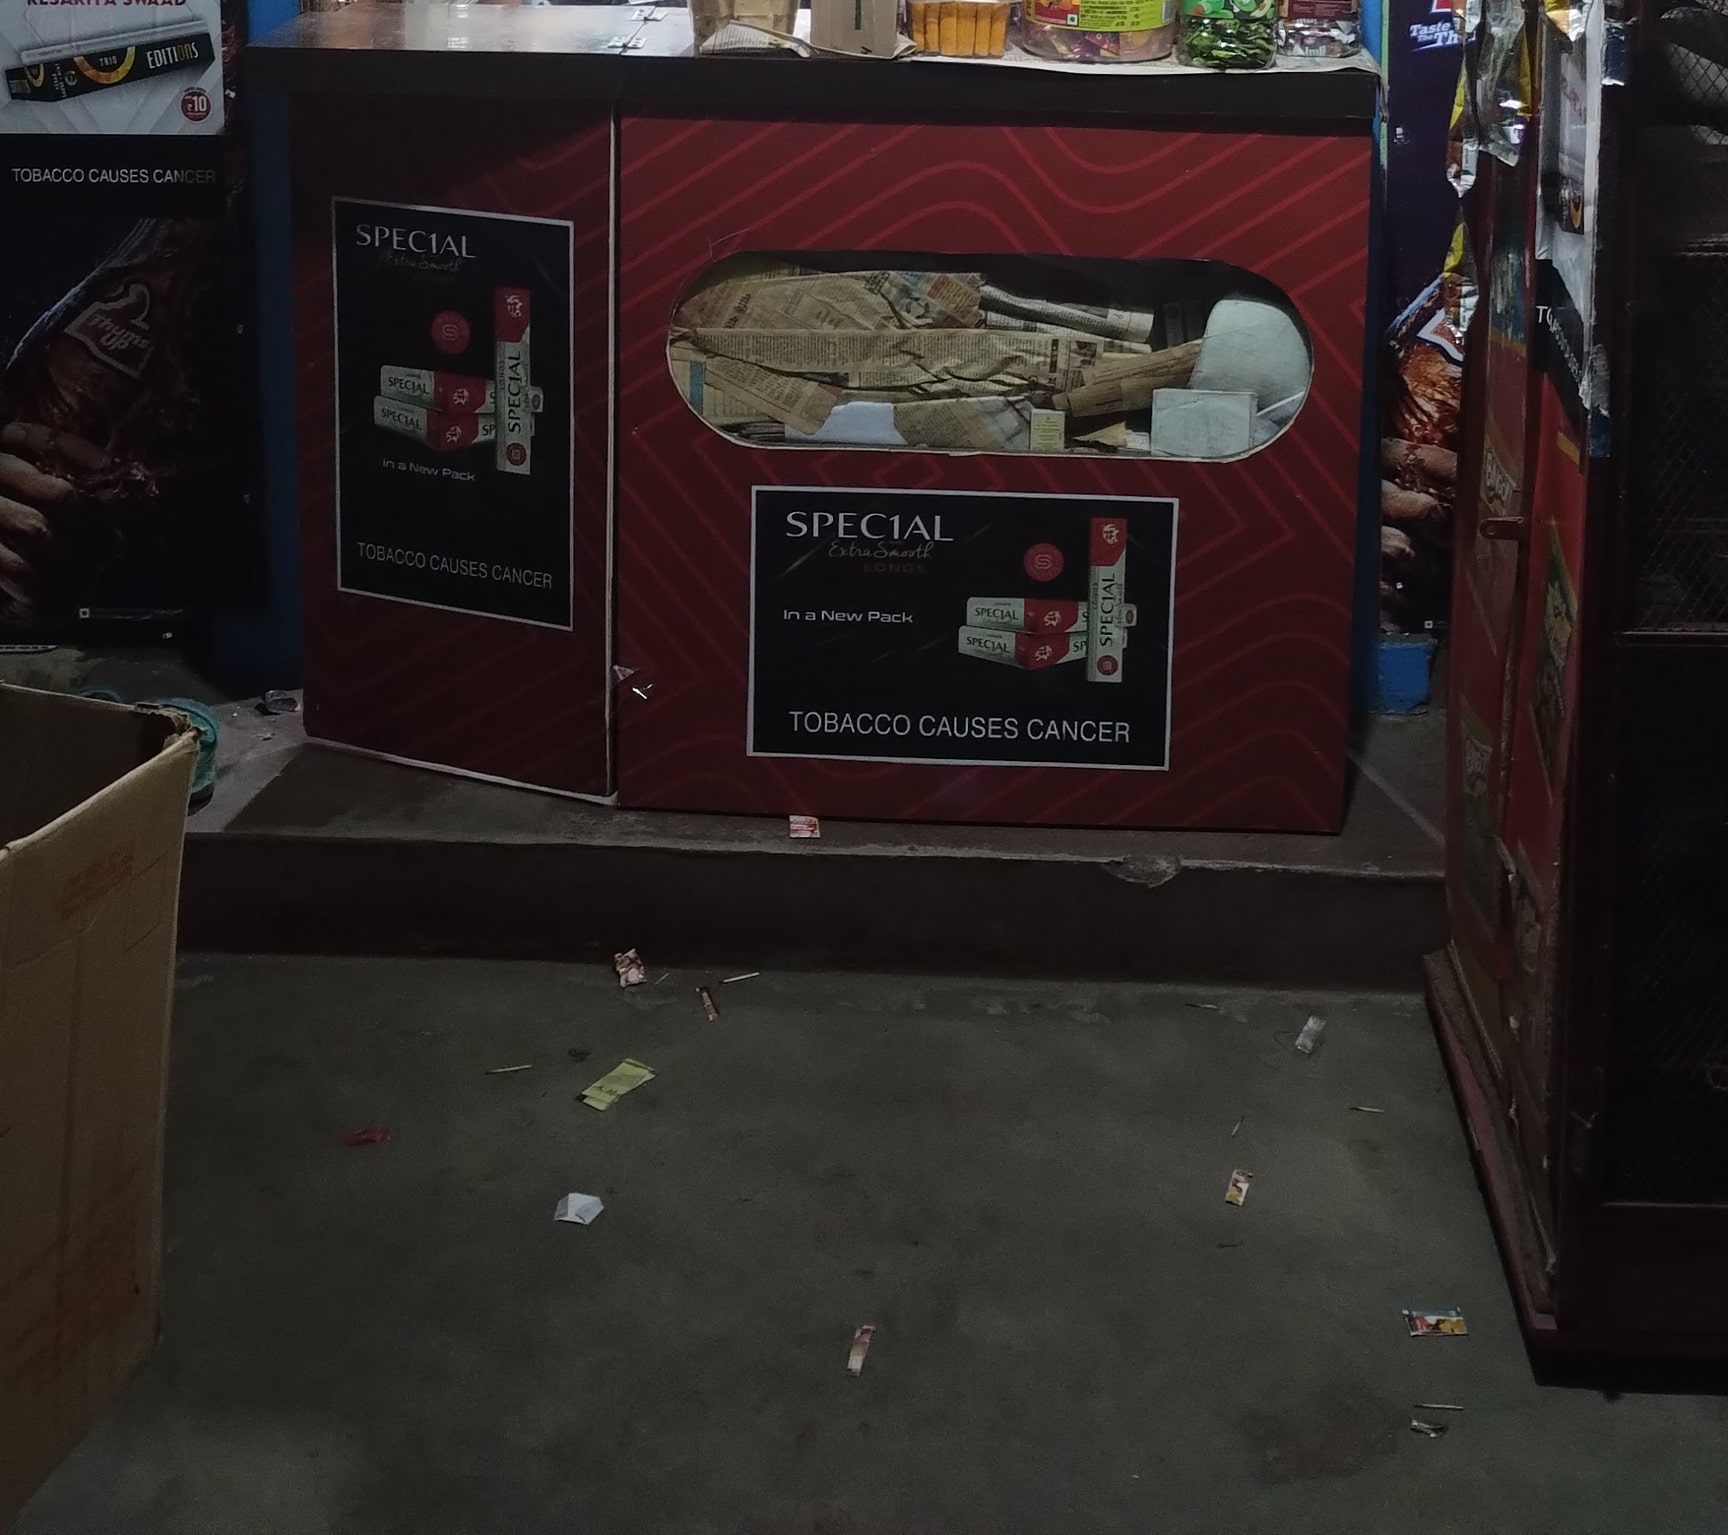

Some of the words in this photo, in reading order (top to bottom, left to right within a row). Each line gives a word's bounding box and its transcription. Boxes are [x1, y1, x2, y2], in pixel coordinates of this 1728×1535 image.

[12, 168, 85, 184] TOBACCO
[89, 168, 150, 184] CAUSES
[153, 168, 216, 184] CANCER
[409, 461, 439, 476] New
[442, 468, 475, 482] Pack
[828, 540, 872, 558] Extra
[873, 540, 935, 560] Smooth
[358, 541, 426, 570] TOBACCO
[429, 555, 488, 580] CAUSES
[491, 565, 553, 589] CANCER
[783, 609, 801, 622] In
[821, 609, 863, 623] New
[867, 610, 914, 624] Pack
[789, 711, 911, 736] TOBACCO
[919, 715, 1018, 740] CAUSES
[1027, 719, 1131, 744] CANCER
